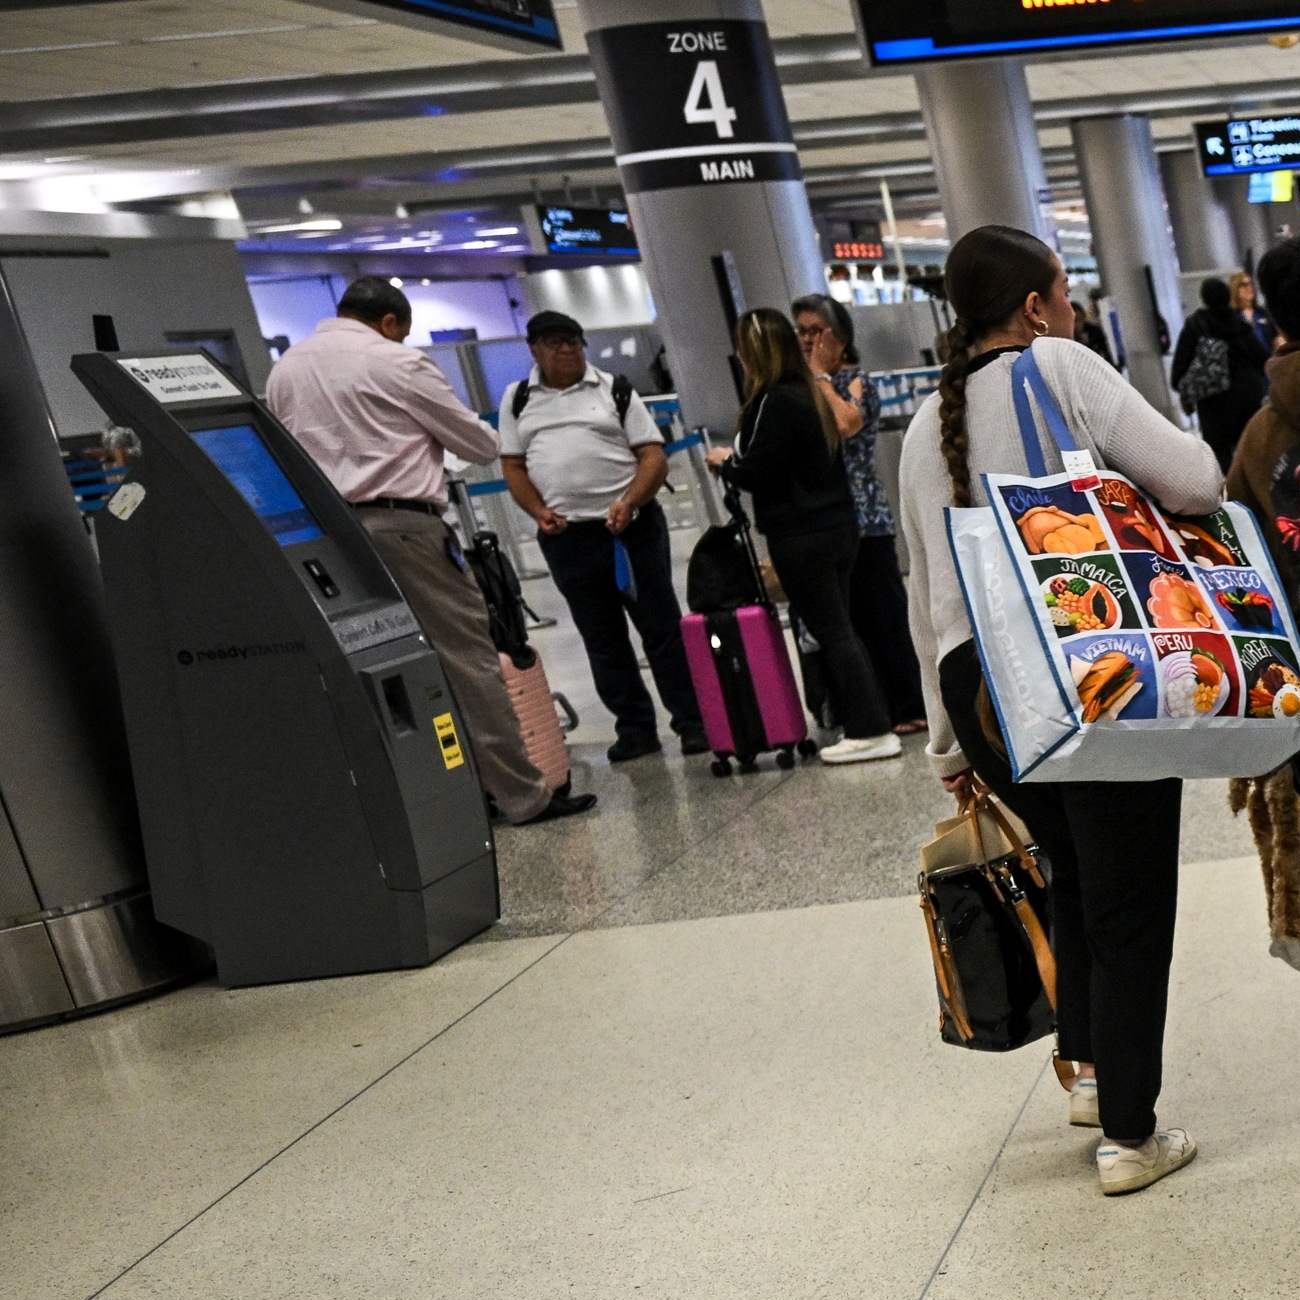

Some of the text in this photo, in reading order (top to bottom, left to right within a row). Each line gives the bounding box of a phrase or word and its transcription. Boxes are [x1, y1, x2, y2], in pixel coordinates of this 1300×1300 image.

[667, 32, 727, 52] ZONE
[684, 60, 737, 138] 4
[700, 159, 755, 182] MAIN
[1210, 511, 1247, 567] TALY
[1060, 559, 1127, 599] JAMAICA
[1199, 570, 1262, 592] MEXICO
[1081, 637, 1147, 662] VIETNAM
[1153, 634, 1194, 654] PERU
[1240, 640, 1274, 670] KOREA
